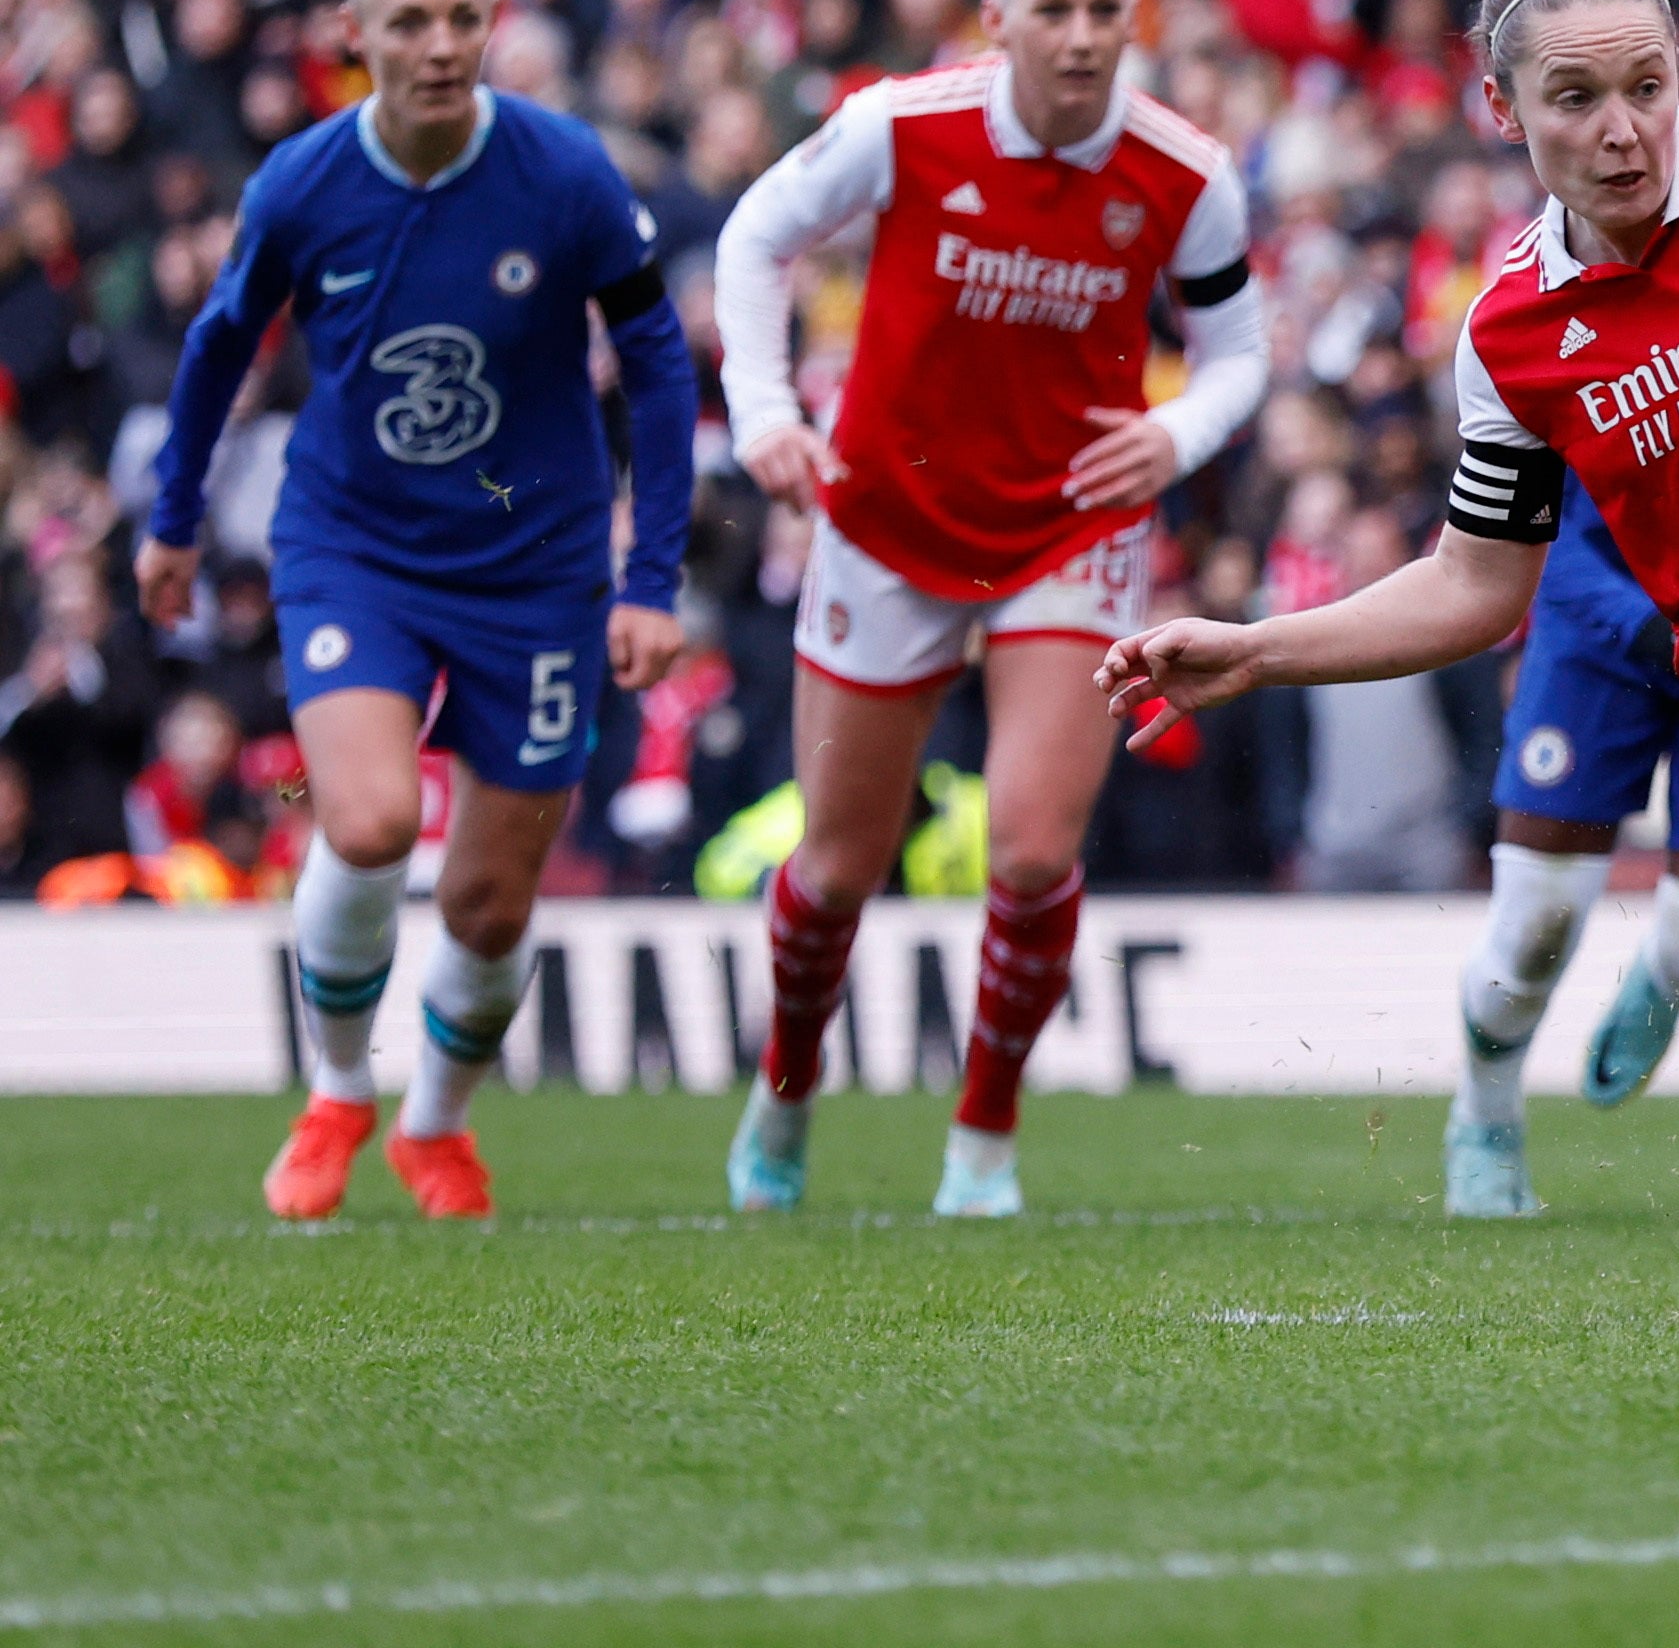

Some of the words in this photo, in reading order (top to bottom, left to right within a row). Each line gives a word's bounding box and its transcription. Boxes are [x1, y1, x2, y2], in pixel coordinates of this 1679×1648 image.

[936, 232, 1130, 303] Emirates
[1559, 329, 1598, 359] adidas
[1628, 409, 1675, 467] FLY
[528, 651, 575, 741] 5
